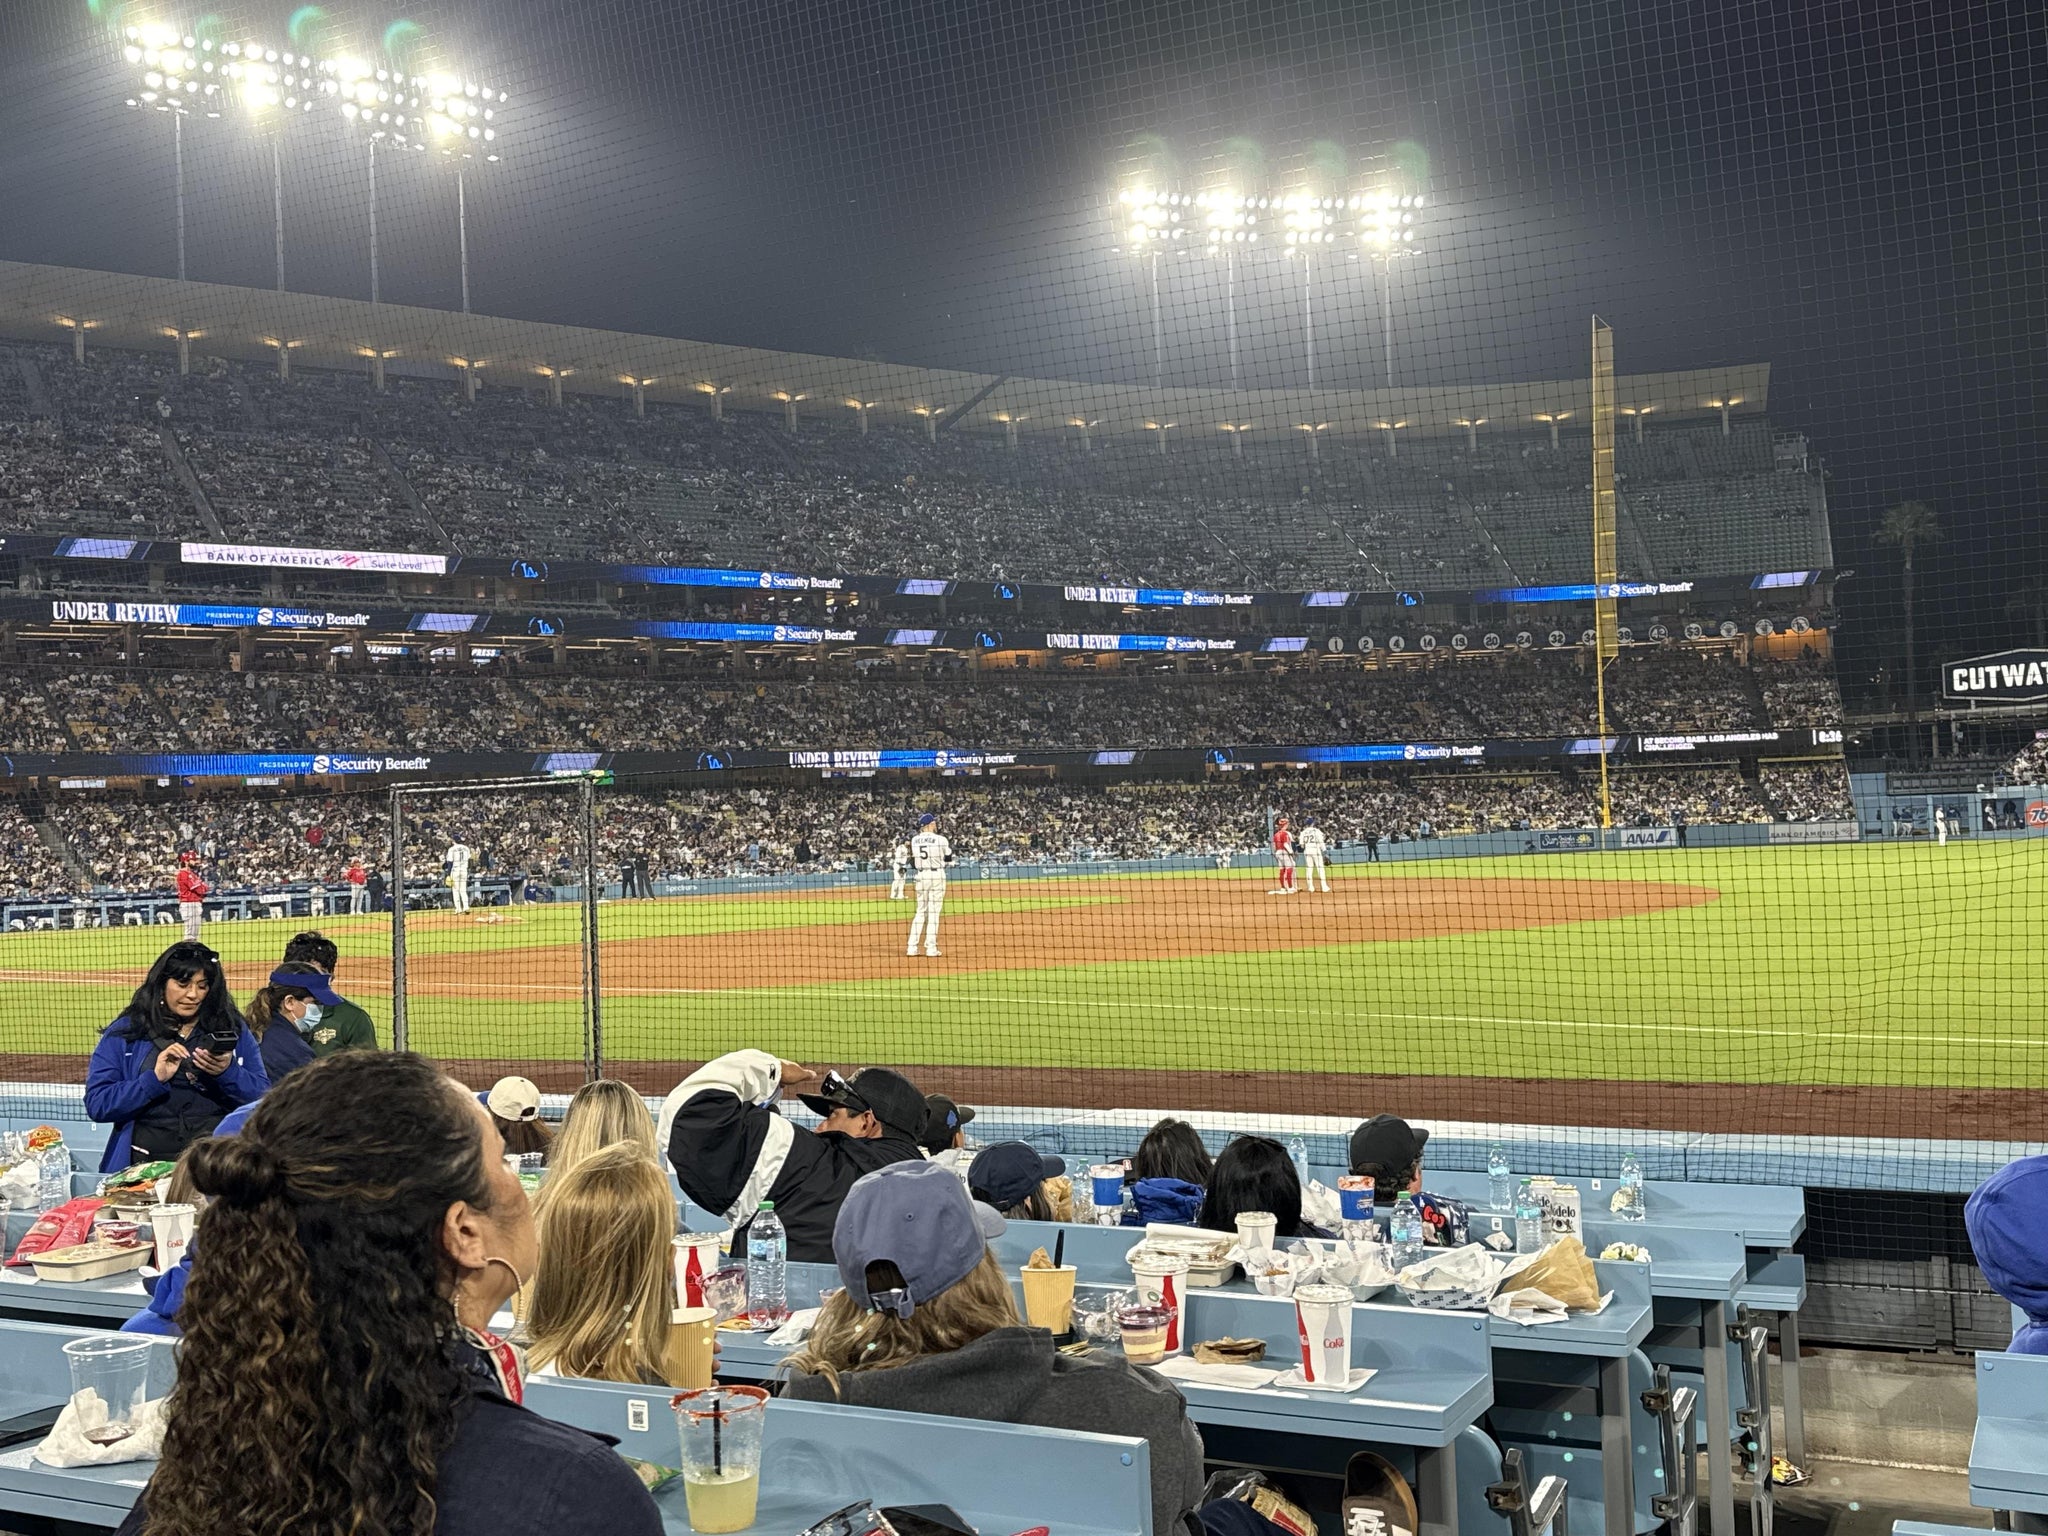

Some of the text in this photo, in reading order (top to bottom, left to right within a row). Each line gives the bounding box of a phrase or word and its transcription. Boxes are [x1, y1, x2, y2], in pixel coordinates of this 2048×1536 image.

[207, 551, 331, 566] BANK OF AMERICA
[371, 559, 397, 569] Suite
[773, 576, 809, 589] Security
[1064, 586, 1138, 604] UNDER REVIEW
[1621, 585, 1659, 595] Security
[1193, 594, 1224, 606] Security
[52, 601, 181, 623] UNDER REVIEW
[276, 611, 325, 627] Security
[788, 629, 824, 641] Security
[1651, 628, 1666, 639] 42
[1046, 633, 1120, 650] UNDER REVIEW
[1177, 639, 1207, 651] Security
[471, 648, 497, 657] PRESS
[1725, 733, 1761, 742] ANGELES
[1416, 746, 1451, 759] Security
[332, 757, 383, 773] Security
[789, 751, 881, 769] UNDER REVIEW
[949, 753, 984, 766] Security
[1626, 833, 1654, 845] ANA
[919, 845, 929, 860] 5
[1323, 1337, 1344, 1349] Coke
